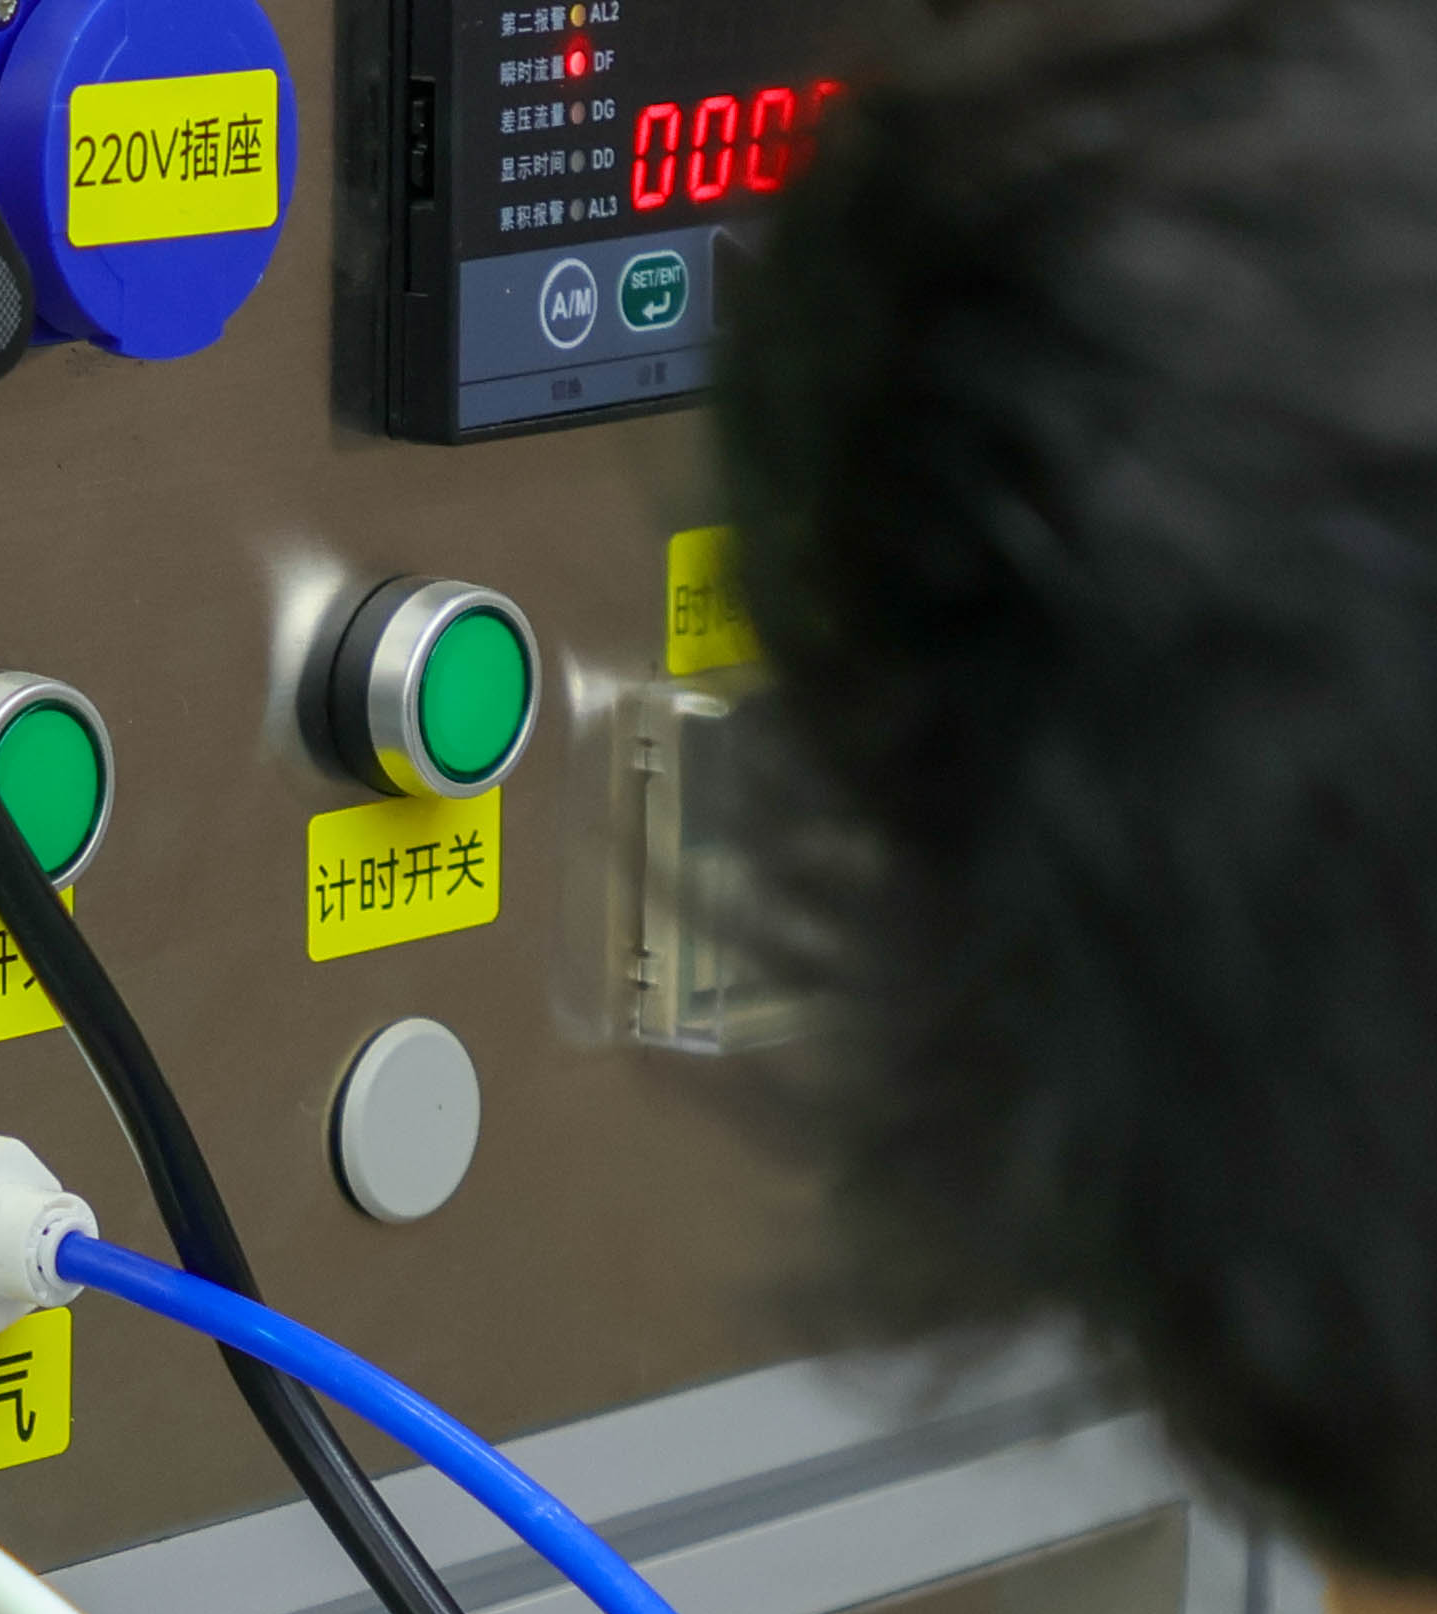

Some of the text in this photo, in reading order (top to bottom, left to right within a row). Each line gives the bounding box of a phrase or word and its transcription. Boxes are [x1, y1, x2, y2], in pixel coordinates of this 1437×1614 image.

[500, 6, 566, 37] 第二报警
[590, 1, 620, 23] AL2
[594, 50, 614, 72] DF
[500, 102, 565, 134] 差压流量
[592, 99, 615, 121] DG
[72, 113, 265, 188] 220V插座
[500, 150, 565, 182] 显示时间
[592, 148, 614, 170] DD
[500, 200, 564, 232] 累积报警
[588, 195, 618, 219] AL3
[631, 265, 682, 289] SET/ENT
[551, 288, 592, 320] A/M
[315, 830, 486, 923] 计时开关
